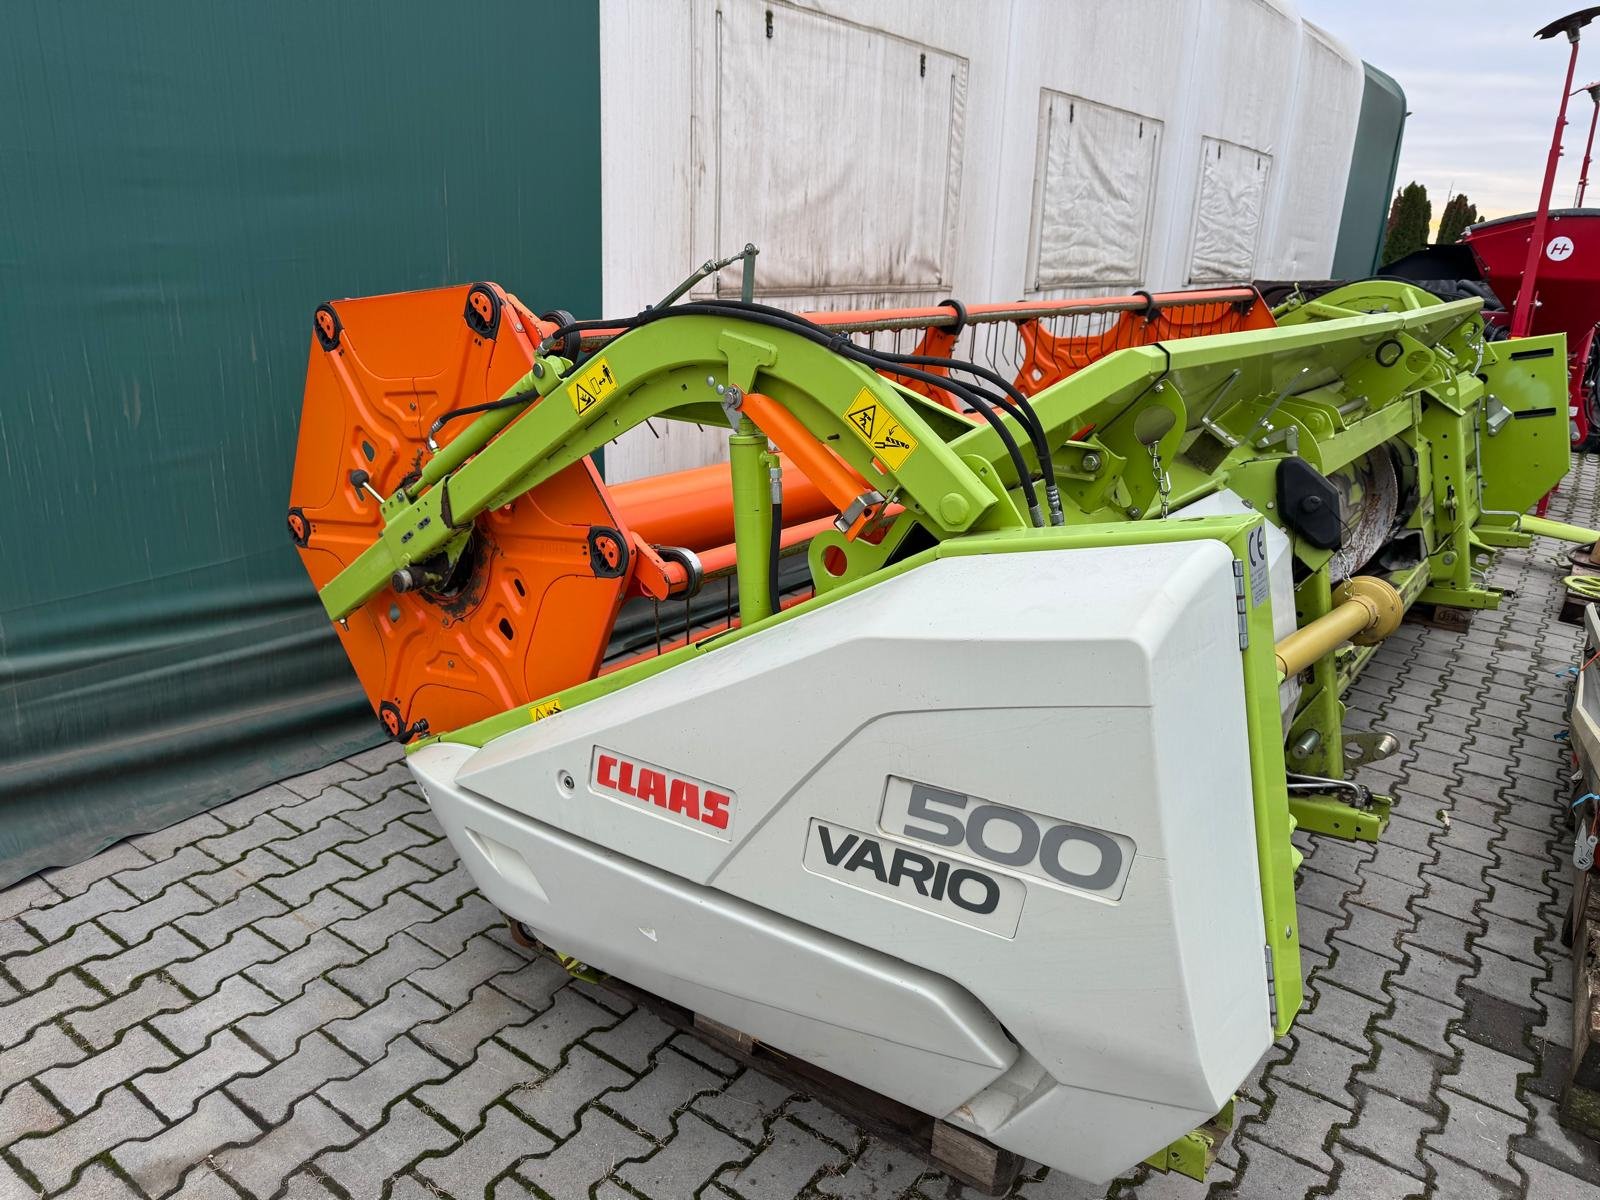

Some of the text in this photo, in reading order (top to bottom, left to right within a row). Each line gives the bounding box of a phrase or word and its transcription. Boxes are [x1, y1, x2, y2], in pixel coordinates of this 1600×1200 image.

[1249, 526, 1264, 567] CE
[597, 755, 730, 829] CLAAS
[818, 825, 1000, 915] VARIO
[903, 784, 1122, 891] 500
